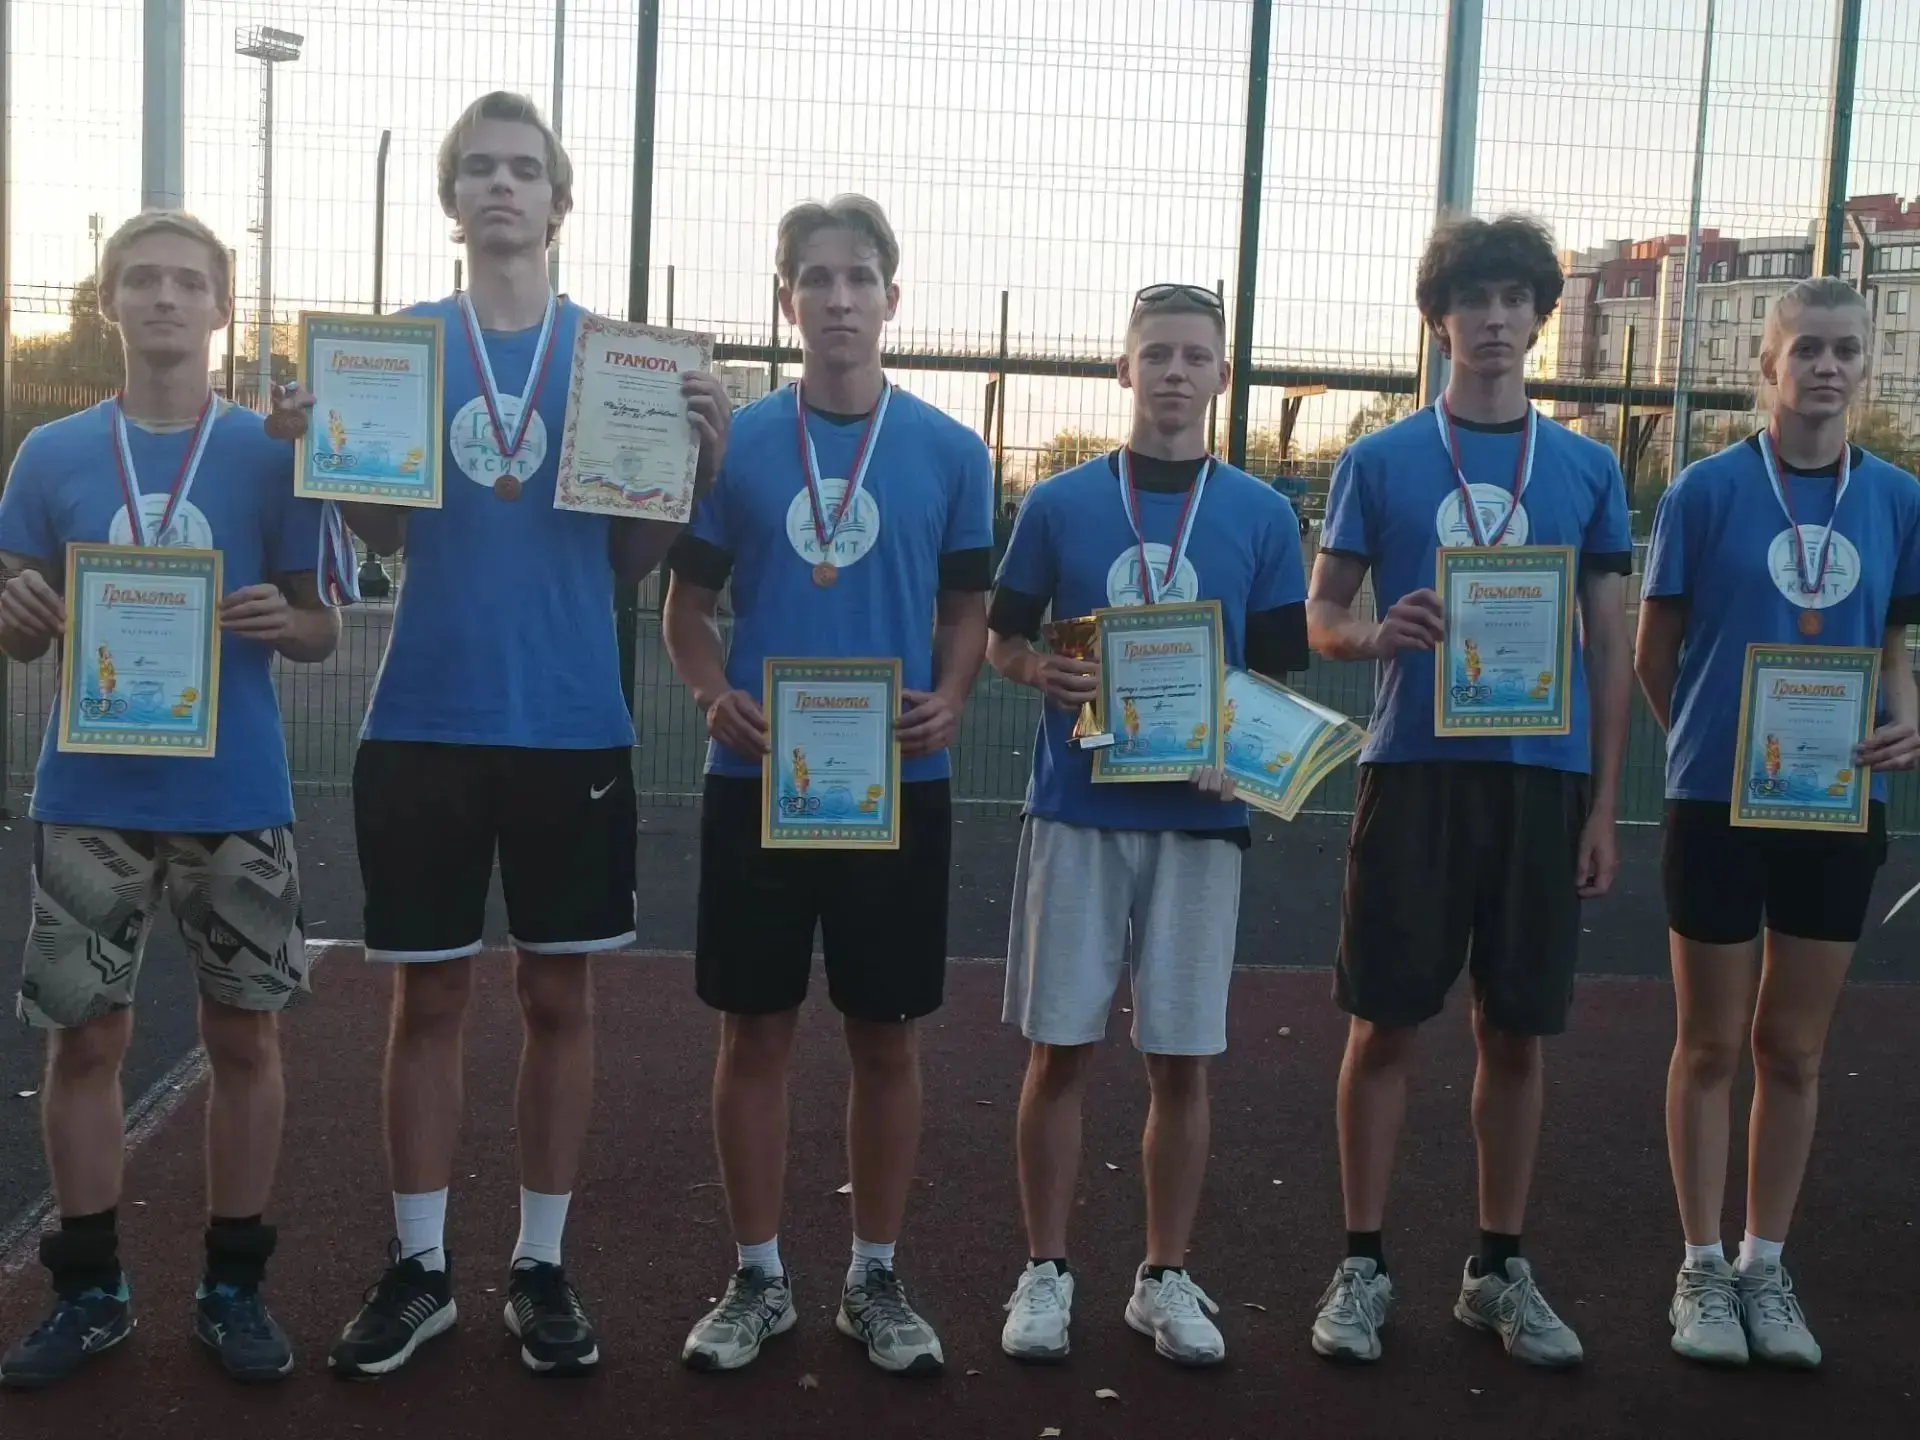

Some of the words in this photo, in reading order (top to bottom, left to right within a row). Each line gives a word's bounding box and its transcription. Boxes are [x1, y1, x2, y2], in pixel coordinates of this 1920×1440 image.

[331, 350, 410, 375] Грамота
[605, 351, 678, 373] ГРАМОТА
[101, 582, 187, 609] Грамота
[1468, 581, 1543, 605] Грамота
[1124, 640, 1194, 663] Грамота
[1772, 678, 1847, 702] Грамота
[795, 691, 870, 715] Грамота
